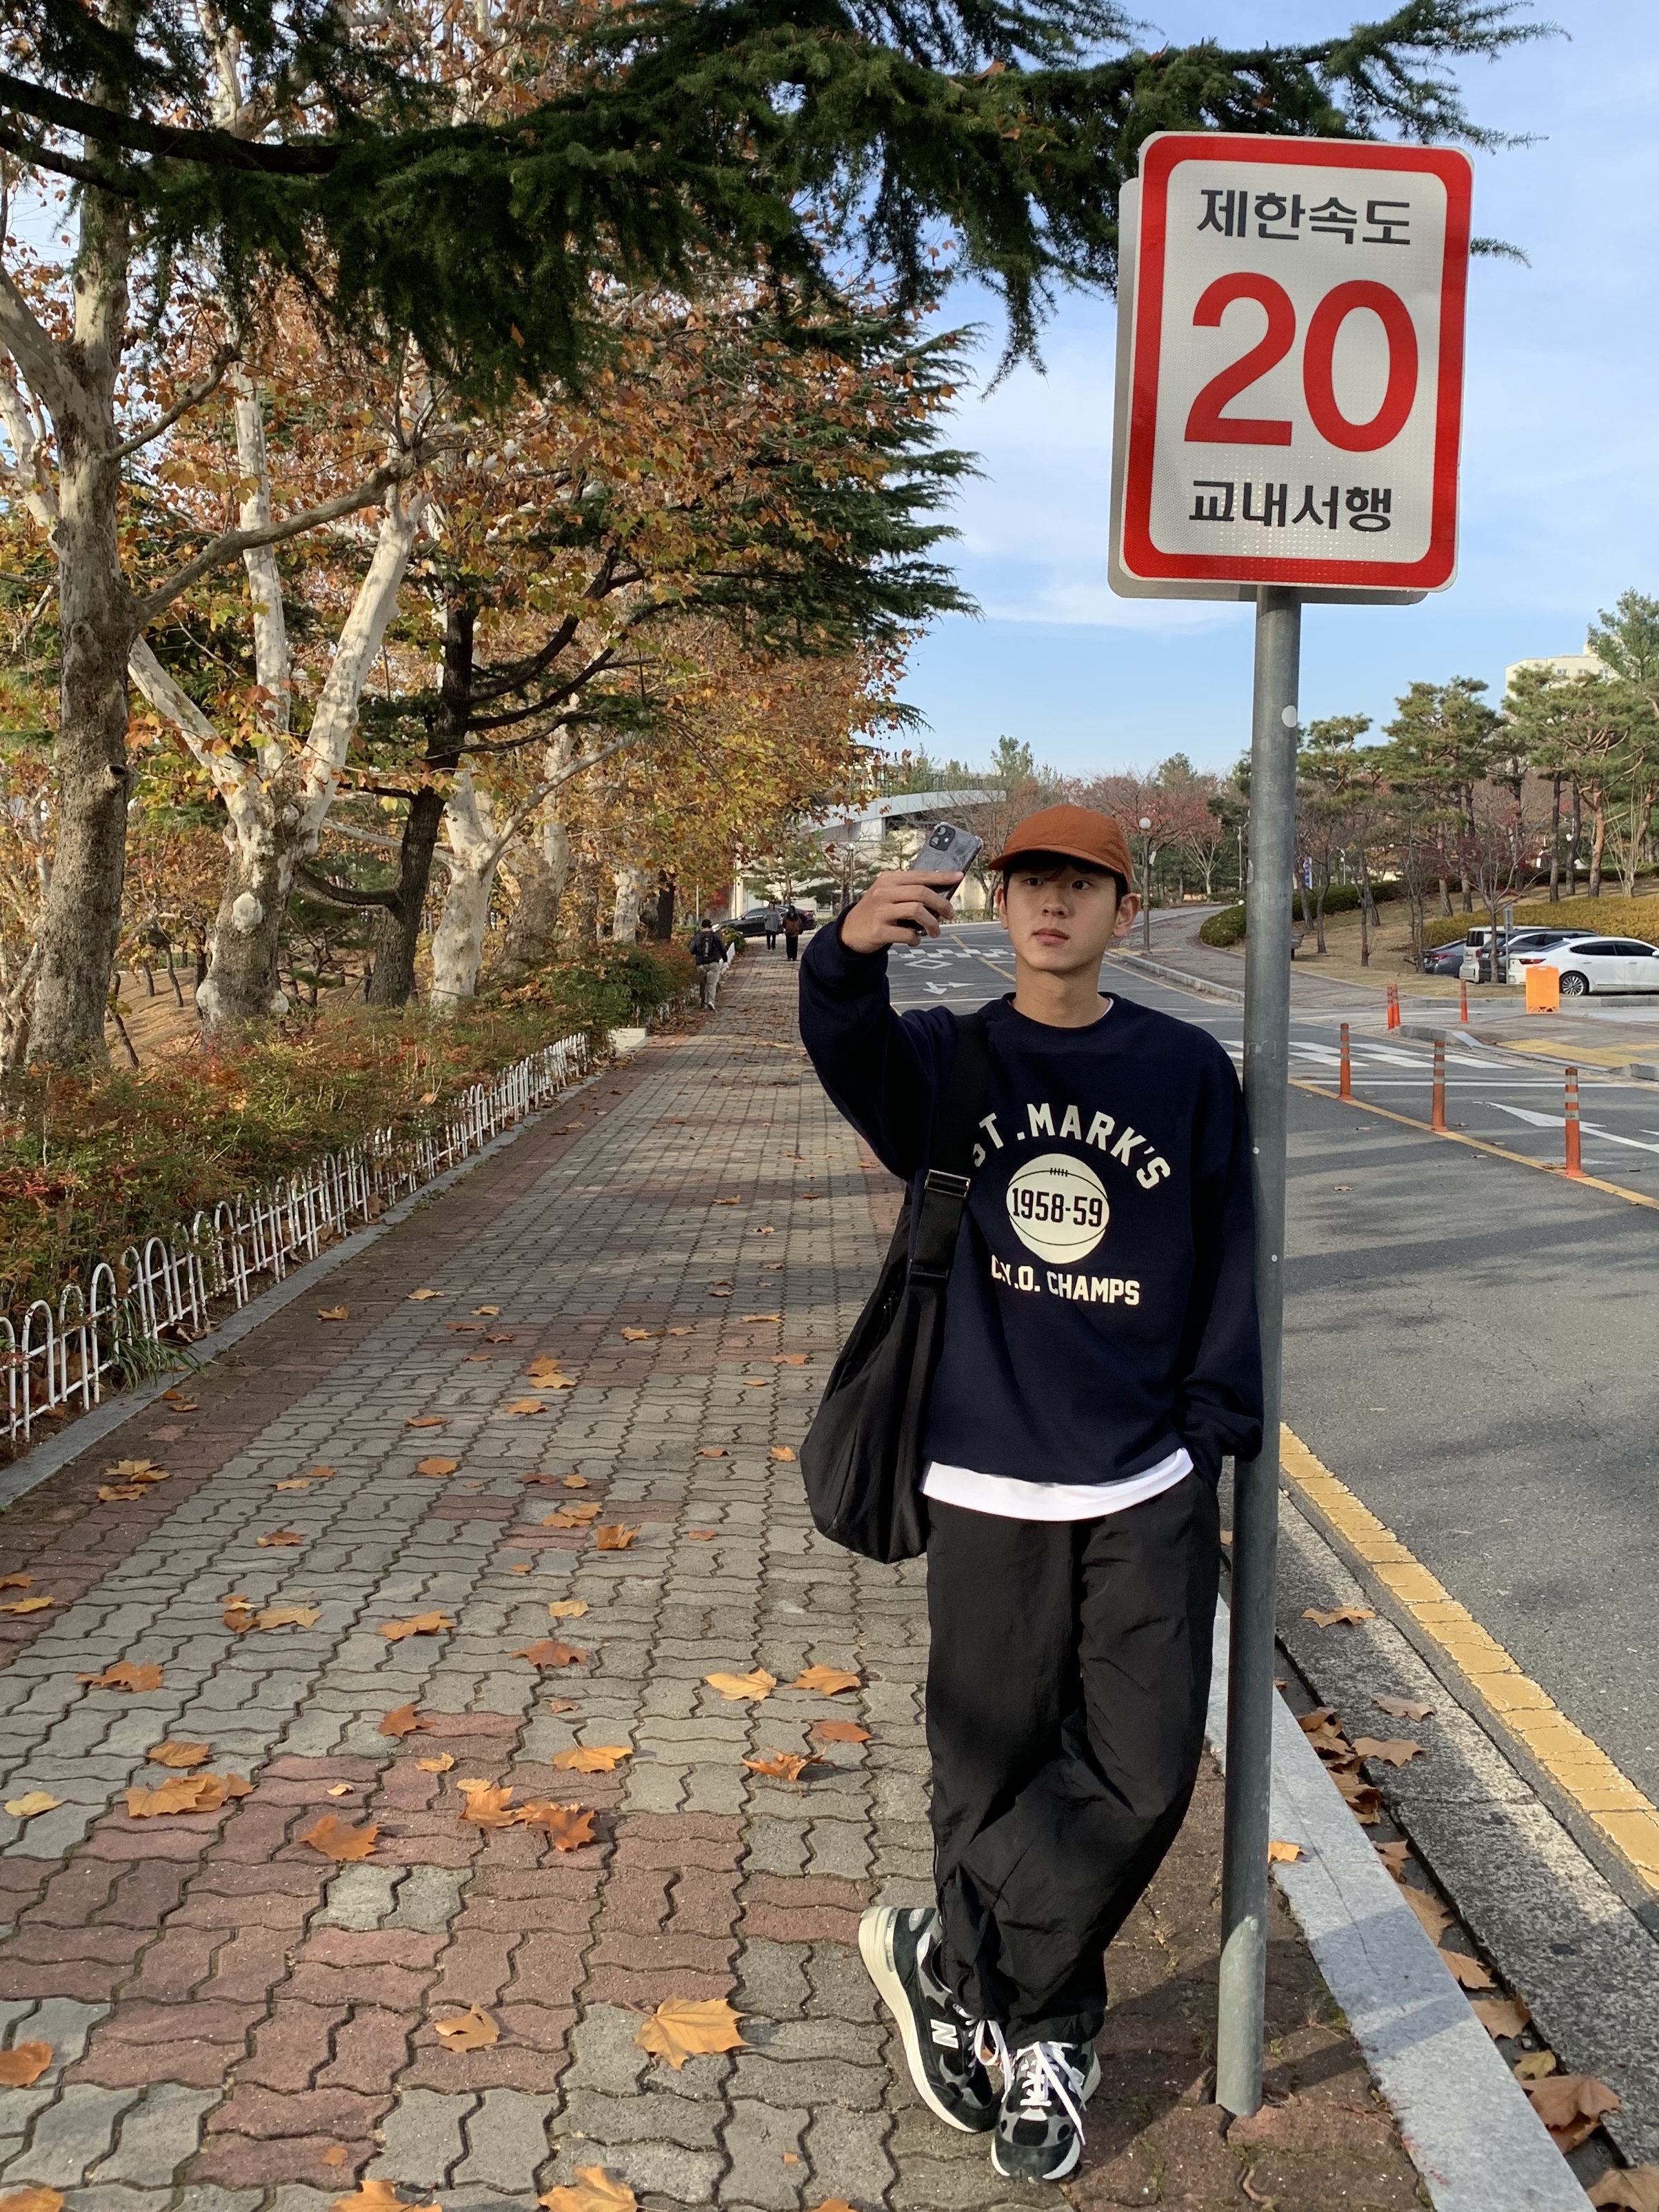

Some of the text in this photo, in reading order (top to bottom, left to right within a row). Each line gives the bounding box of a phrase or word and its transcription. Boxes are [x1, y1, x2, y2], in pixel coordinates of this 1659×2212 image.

[1196, 189, 1411, 245] 제한속도
[1184, 272, 1419, 453] 20
[1189, 480, 1392, 533] 교내서행
[1012, 1187, 1103, 1227] 1958-59
[1046, 1270, 1140, 1306] CHAMPS
